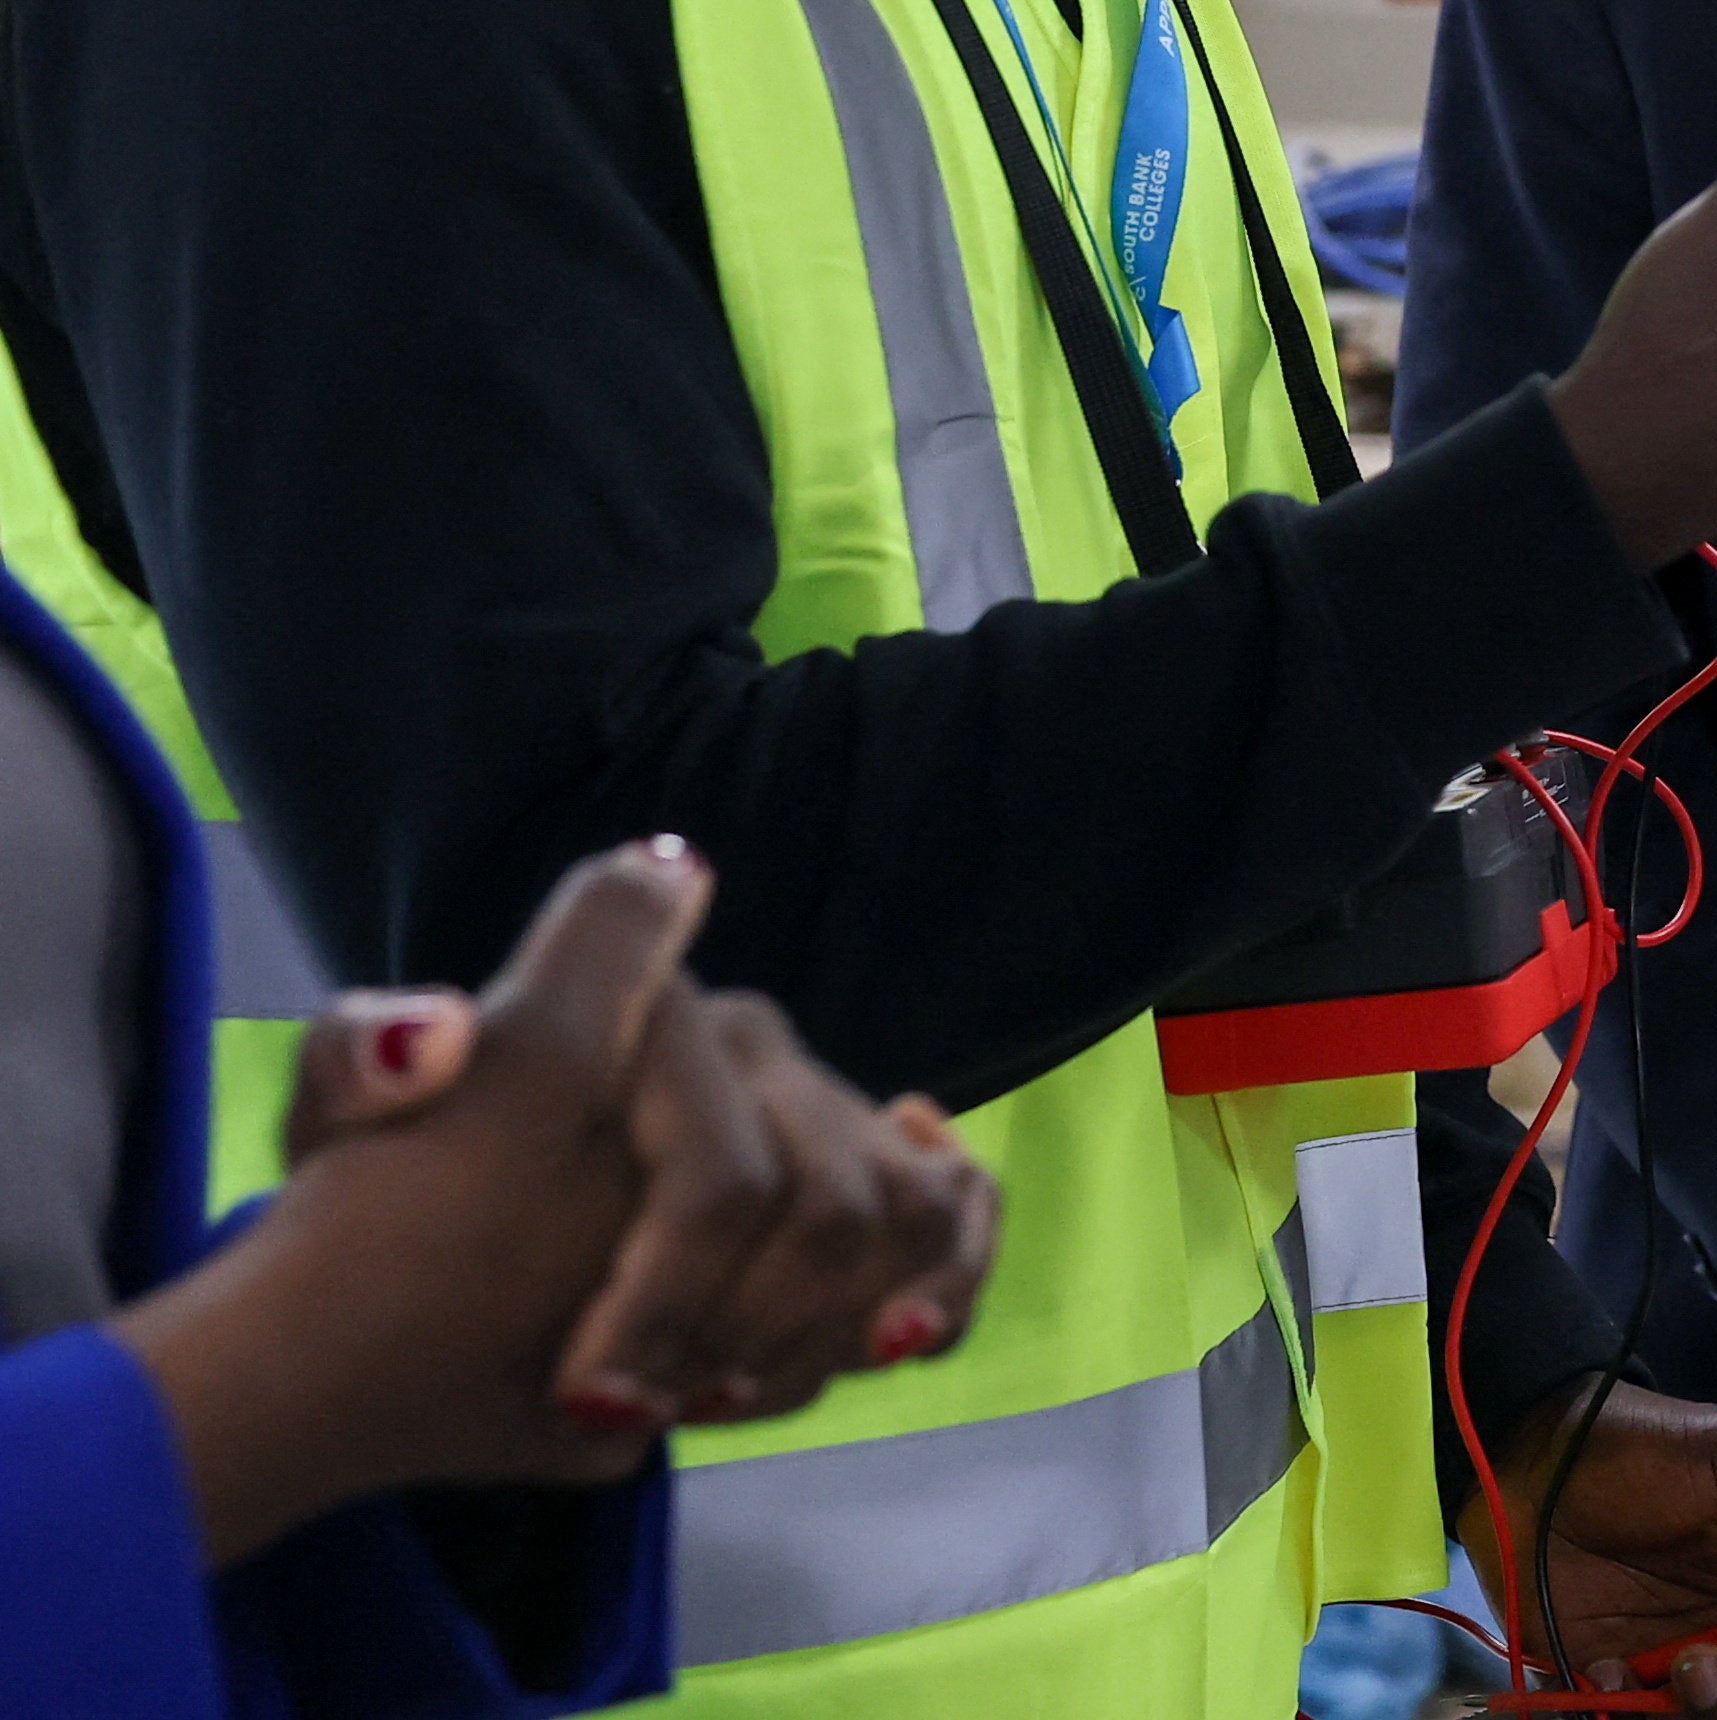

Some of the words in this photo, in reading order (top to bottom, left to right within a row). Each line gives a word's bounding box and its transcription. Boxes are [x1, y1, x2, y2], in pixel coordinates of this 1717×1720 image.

[1128, 152, 1153, 206] BANK
[1138, 147, 1172, 242] COLLEGES
[1122, 210, 1141, 274] SOUTH
